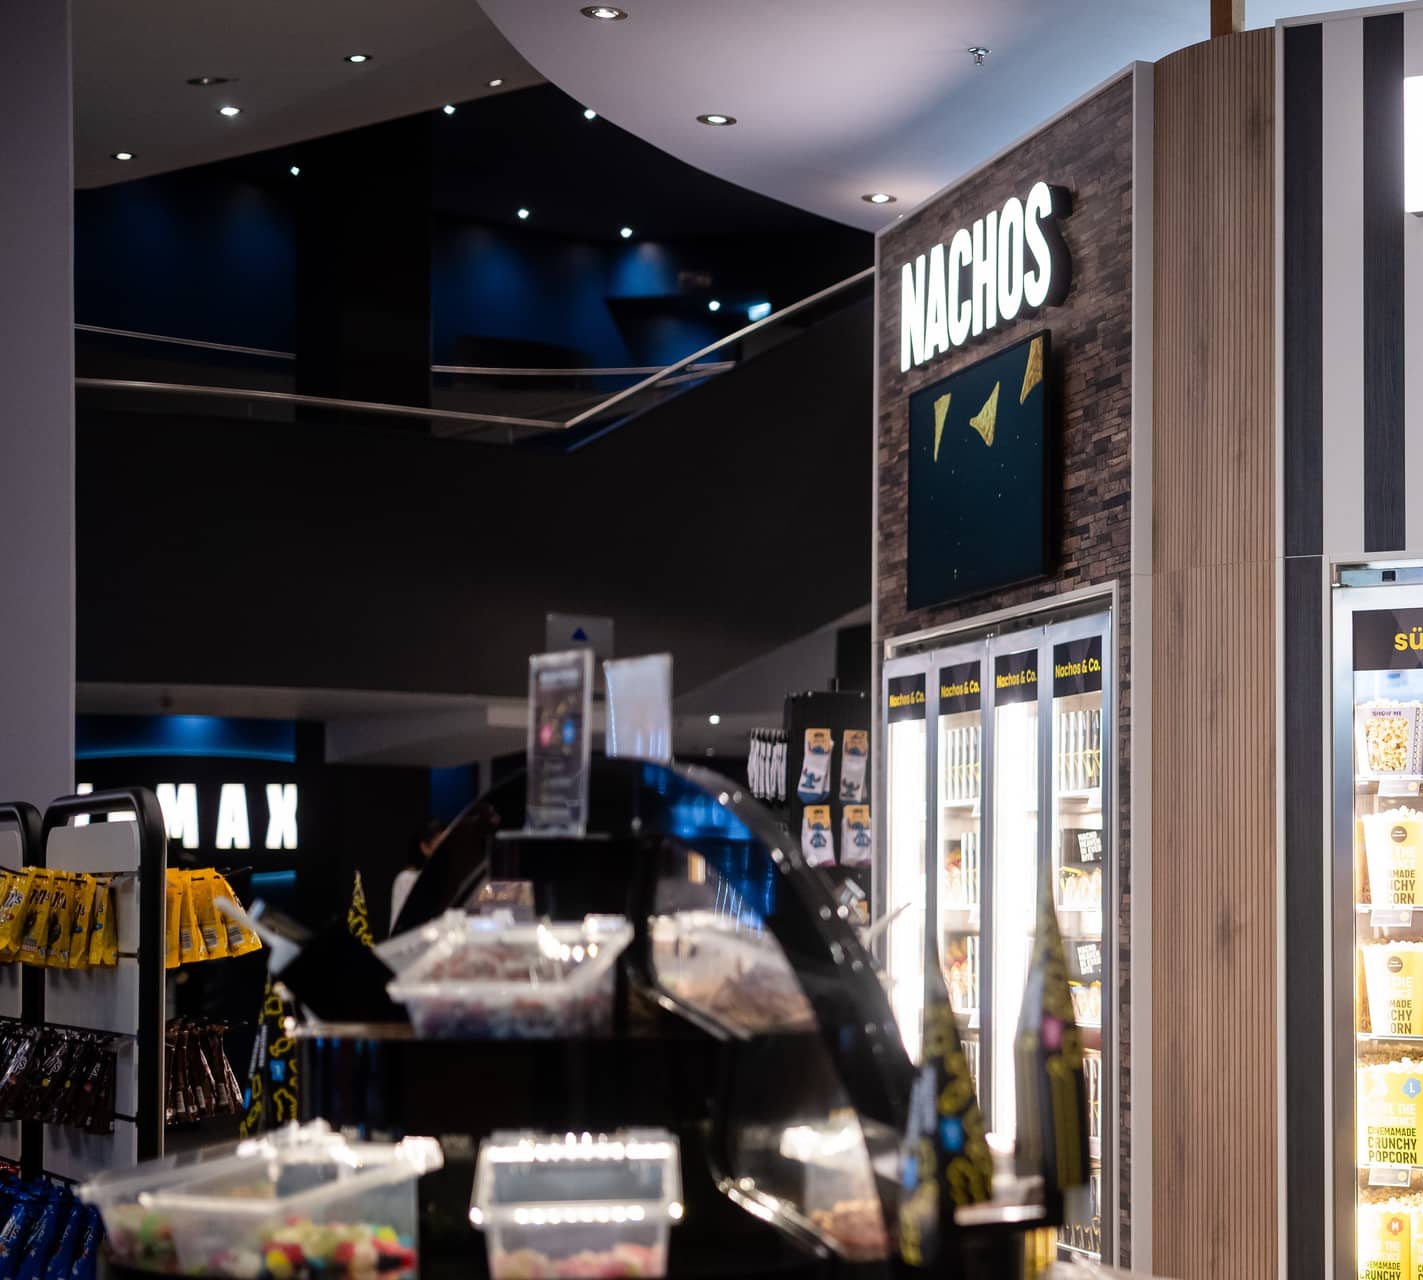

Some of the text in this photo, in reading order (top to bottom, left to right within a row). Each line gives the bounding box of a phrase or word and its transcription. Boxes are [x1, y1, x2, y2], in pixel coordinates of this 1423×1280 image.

[901, 181, 1053, 374] NACHOS
[1055, 658, 1100, 678] Nachos & Co.
[997, 669, 1037, 688] Nachos & Co.
[941, 680, 980, 698] Nachos & Co.
[889, 694, 910, 707] Nachos
[1409, 1082, 1416, 1093] L
[1368, 1137, 1417, 1150] CRUNCHY
[1369, 1150, 1417, 1164] POPCORN
[1392, 1221, 1399, 1231] M
